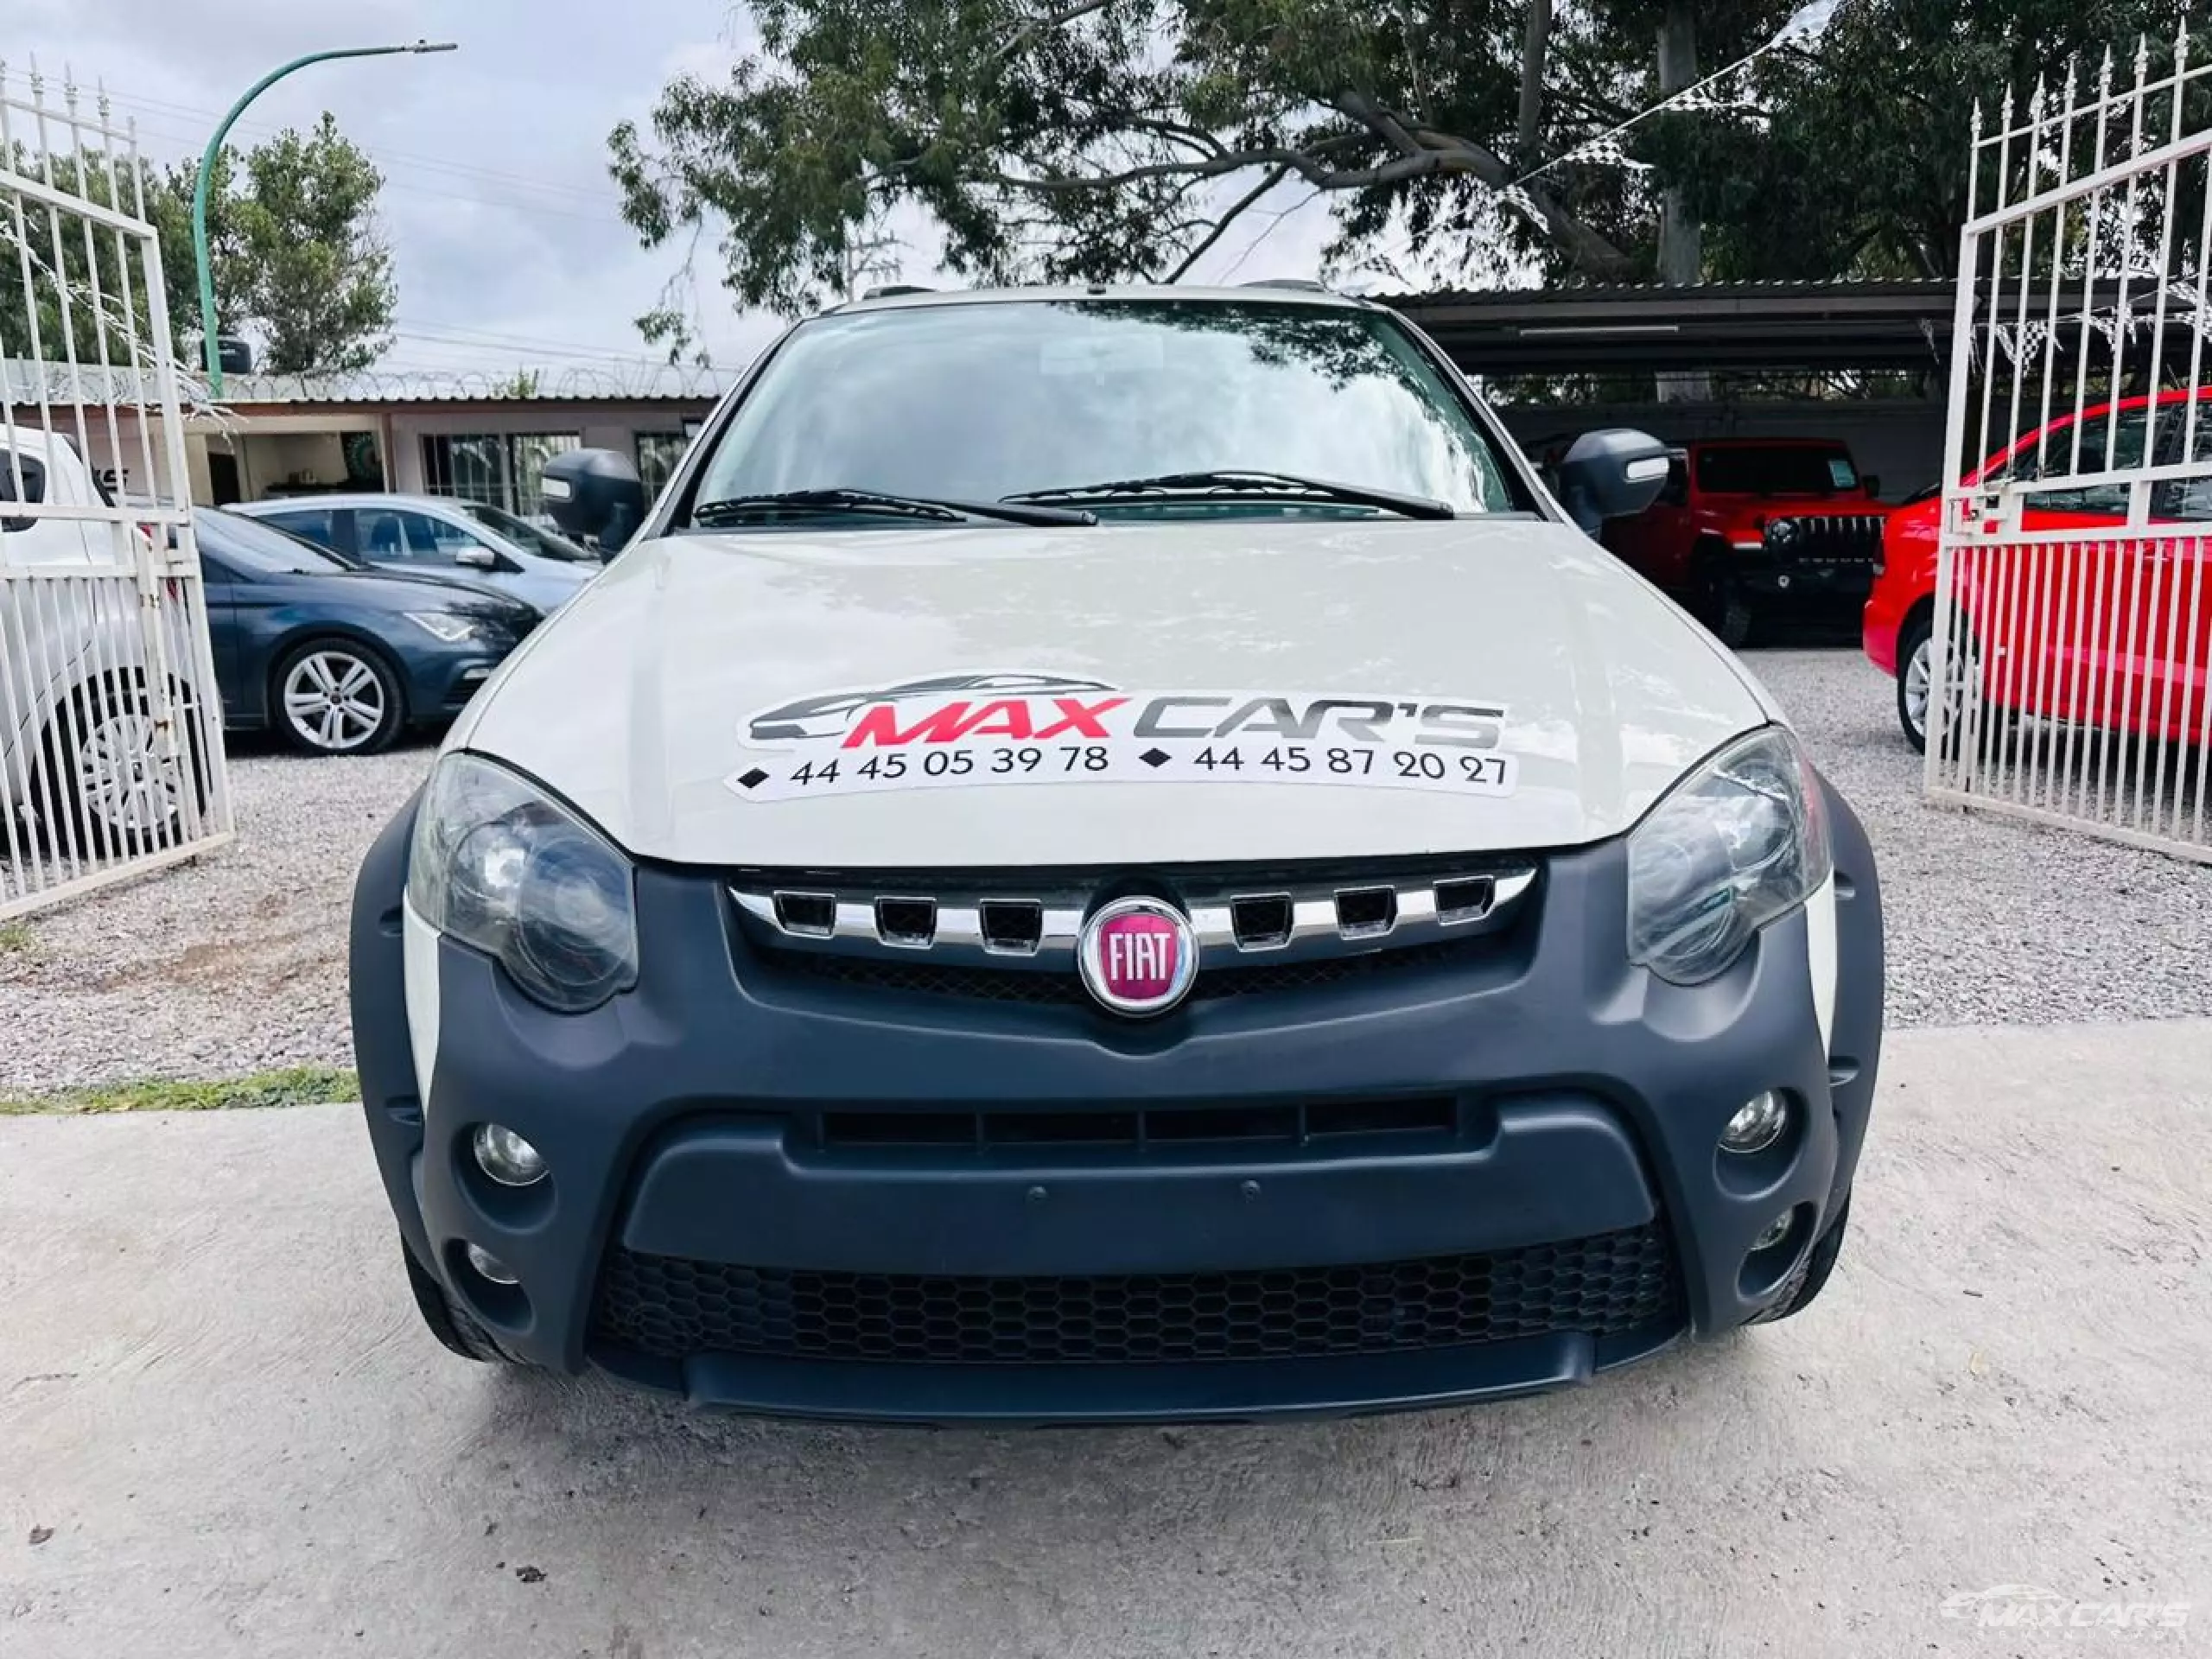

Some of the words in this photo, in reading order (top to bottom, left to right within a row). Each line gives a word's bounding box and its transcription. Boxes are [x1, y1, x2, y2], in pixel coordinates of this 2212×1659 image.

[842, 698, 1132, 748] MAX
[1134, 696, 1504, 749] CAR'S
[790, 758, 841, 785] 44
[857, 753, 906, 779] 45
[924, 750, 974, 776] 05
[991, 747, 1041, 773] 39
[1059, 747, 1109, 772] 78
[1194, 747, 1244, 771] 44
[1261, 747, 1311, 772] 45
[1327, 747, 1374, 774] 87
[1393, 751, 1446, 779] 20
[1459, 756, 1506, 785] 27
[1109, 933, 1170, 980] FIAT
